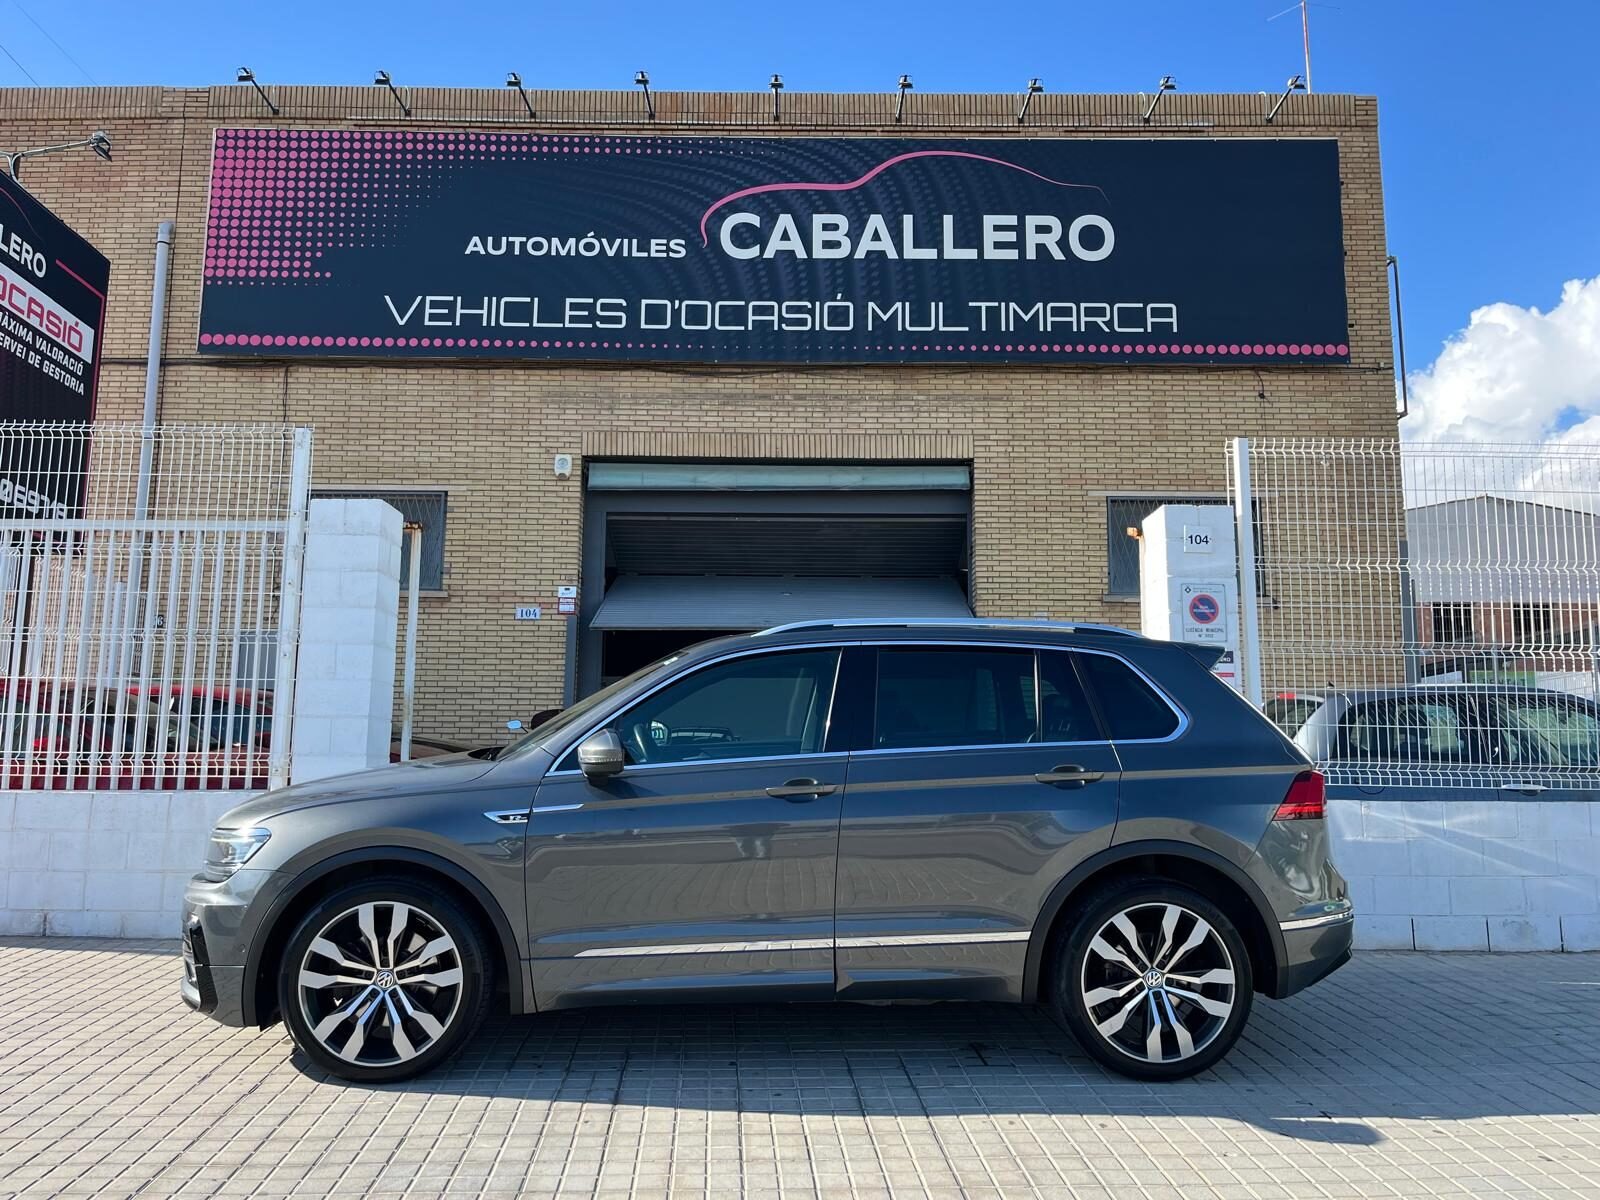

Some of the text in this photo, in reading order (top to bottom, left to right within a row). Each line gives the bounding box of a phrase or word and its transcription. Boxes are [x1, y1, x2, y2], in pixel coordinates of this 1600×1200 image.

[464, 212, 1116, 263] AUTOMÓVILES CABALLERO
[384, 293, 1179, 334] VEHICLES D'OCASIÓ MULTIMARCA
[0, 311, 84, 377] ÀXIMA VALORACIÓ
[27, 350, 42, 369] DE
[42, 360, 85, 396] GESTORIA
[1188, 534, 1210, 545] 104
[520, 608, 537, 618] 104
